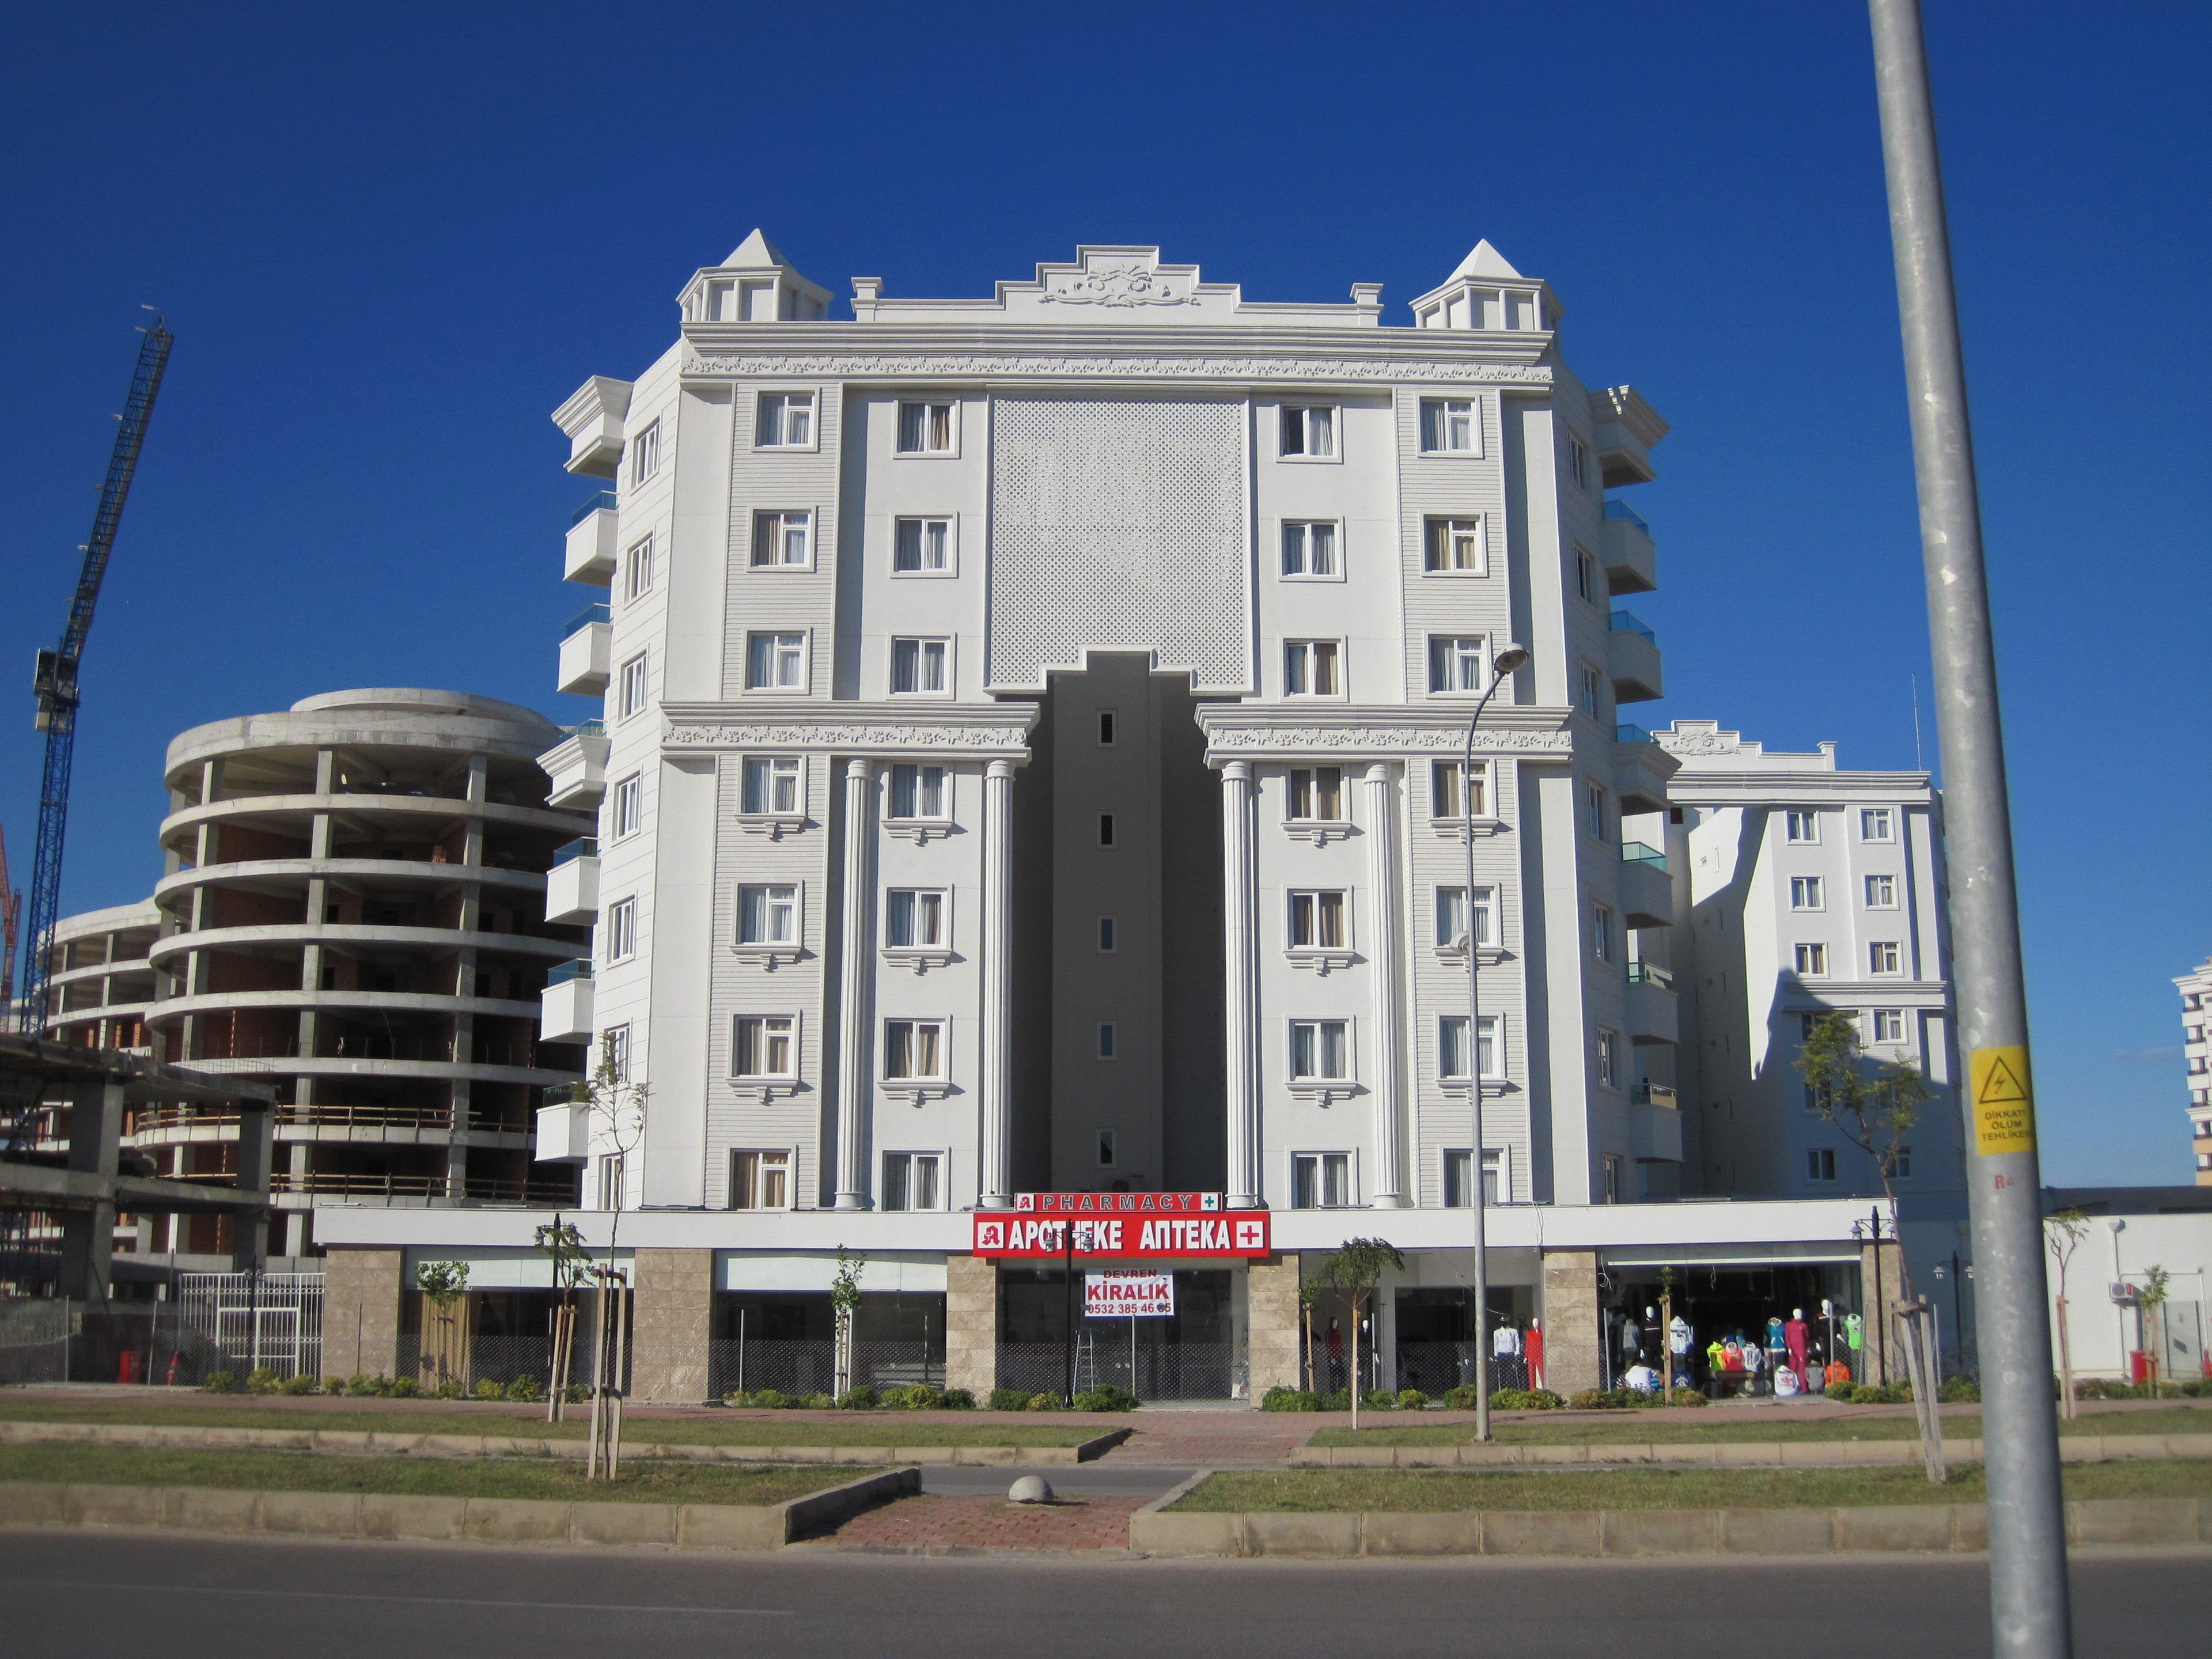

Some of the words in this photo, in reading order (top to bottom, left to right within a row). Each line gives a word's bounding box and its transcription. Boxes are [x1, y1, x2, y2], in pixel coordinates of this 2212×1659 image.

[1043, 1195, 1193, 1210] PHARMACY
[1139, 1220, 1231, 1250] АПТЕКА
[1104, 1269, 1157, 1278] DEVREN
[1088, 1281, 1169, 1300] KİRALIK
[1088, 1304, 1114, 1313] 0532
[1118, 1304, 1138, 1313] 385
[1141, 1303, 1154, 1313] 46
